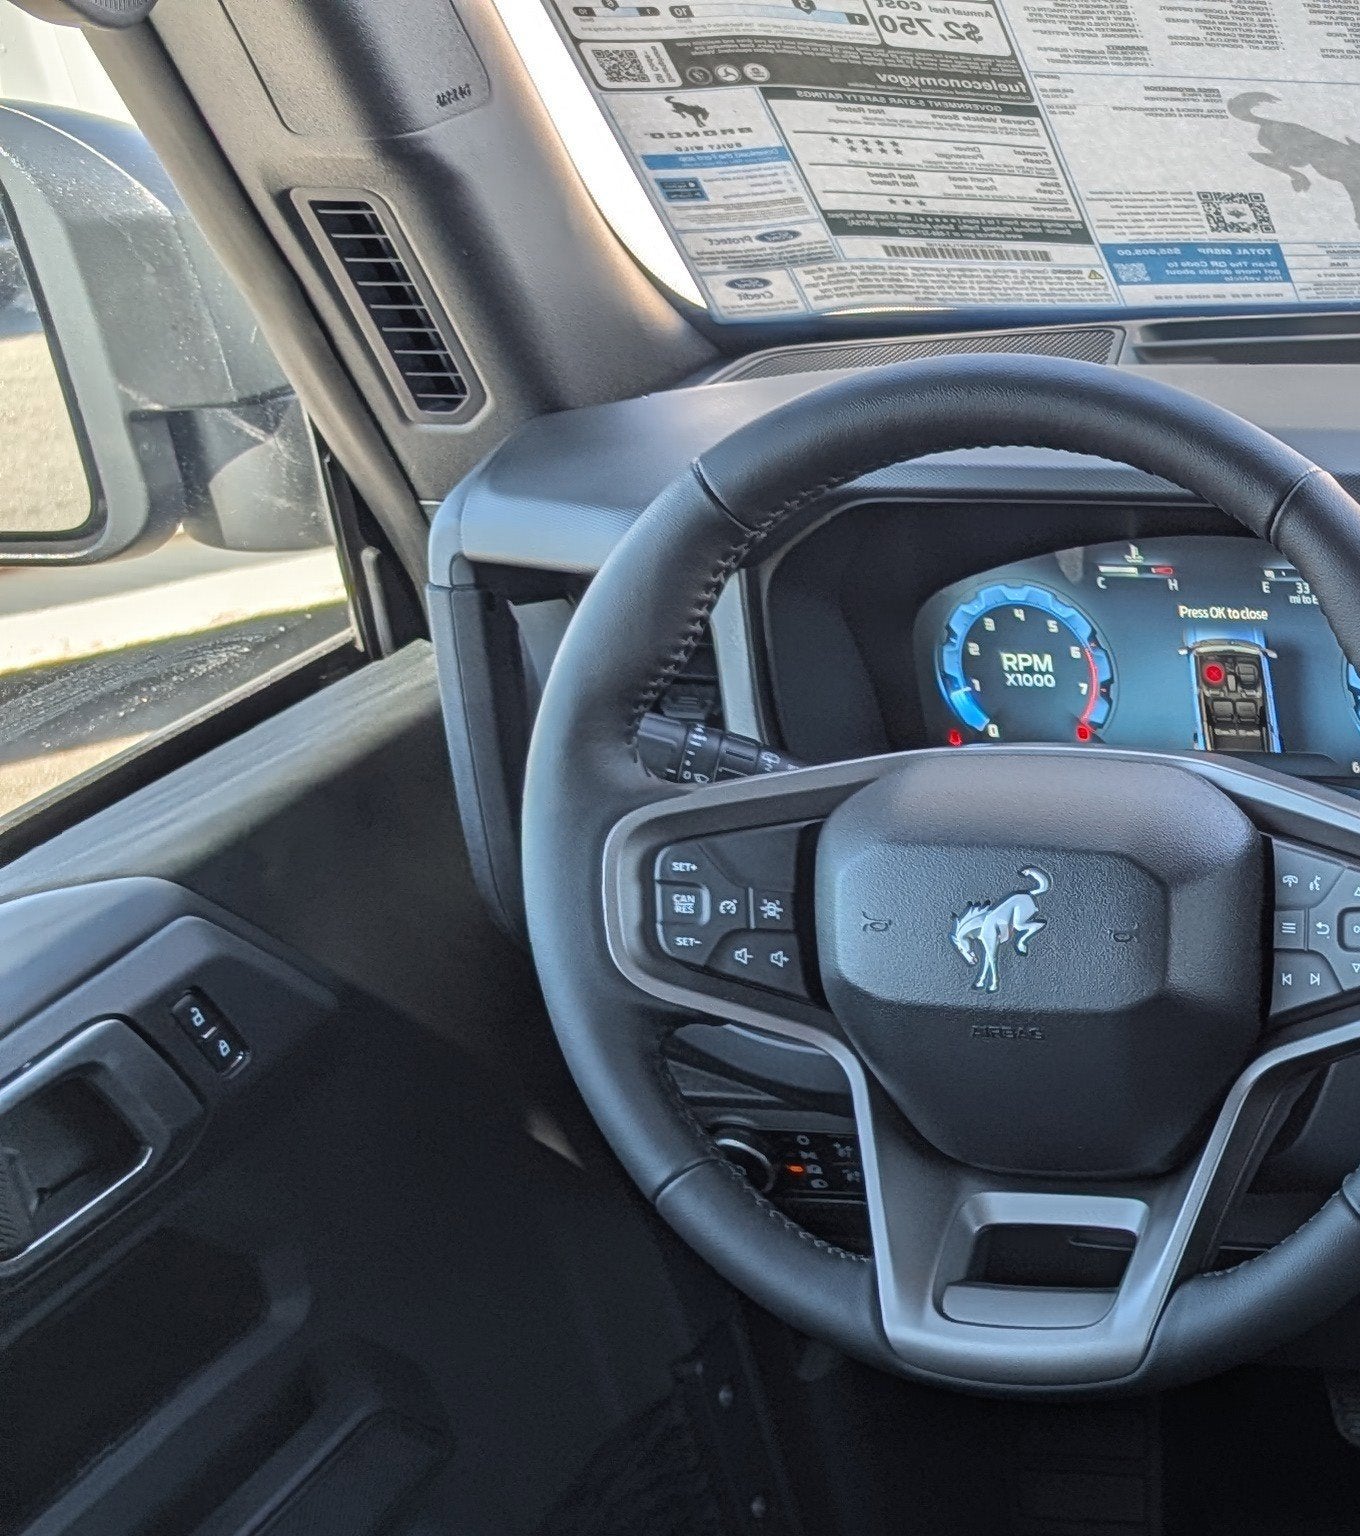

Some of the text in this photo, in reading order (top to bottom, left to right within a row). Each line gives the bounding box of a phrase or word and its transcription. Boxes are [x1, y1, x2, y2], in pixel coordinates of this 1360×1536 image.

[1097, 576, 1107, 590] C
[1168, 578, 1179, 591] H
[1262, 580, 1270, 593] E
[1014, 608, 1025, 622] 4
[1179, 605, 1268, 622] Press OK to close
[984, 618, 994, 631] 3
[1048, 620, 1058, 634] 5
[968, 642, 980, 656] 2
[1070, 646, 1081, 659] 6
[1002, 653, 1054, 673] RPM
[972, 679, 981, 692] 1
[1005, 673, 1056, 688] X1000
[1079, 683, 1088, 696] 7
[988, 724, 999, 738] 0
[671, 862, 699, 873] SET+
[673, 895, 696, 904] CAN
[674, 905, 694, 914] RES
[971, 1024, 1046, 1041] AIRBAG
